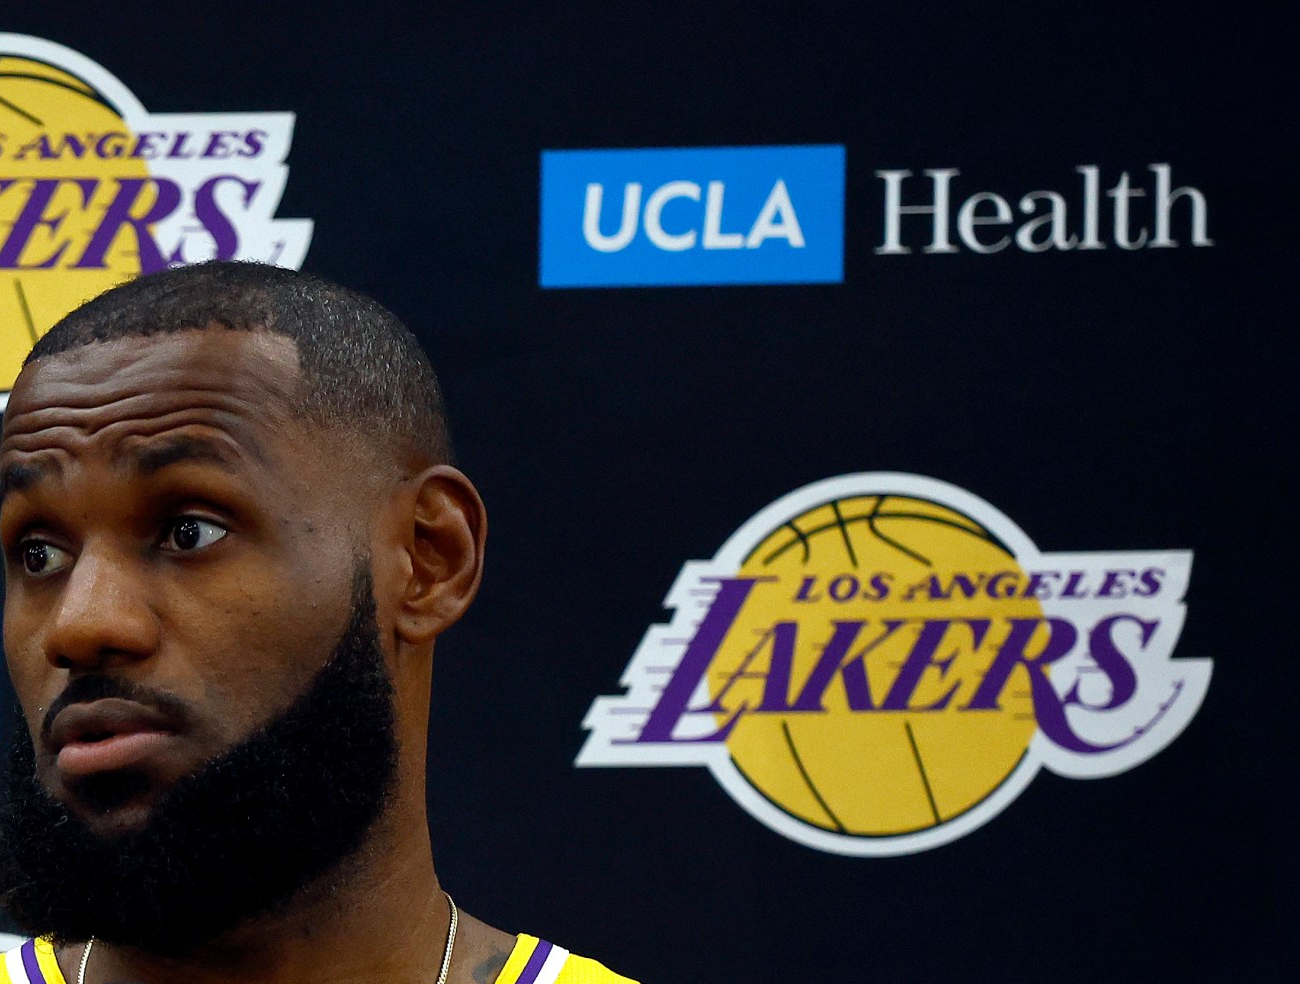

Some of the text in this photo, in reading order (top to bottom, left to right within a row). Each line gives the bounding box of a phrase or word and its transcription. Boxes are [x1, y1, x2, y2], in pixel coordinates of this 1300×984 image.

[15, 130, 268, 159] ANGELES
[582, 163, 1214, 255] UCLA Health
[792, 567, 1165, 602] LOS ANGELES
[611, 576, 1184, 755] LAKERS
